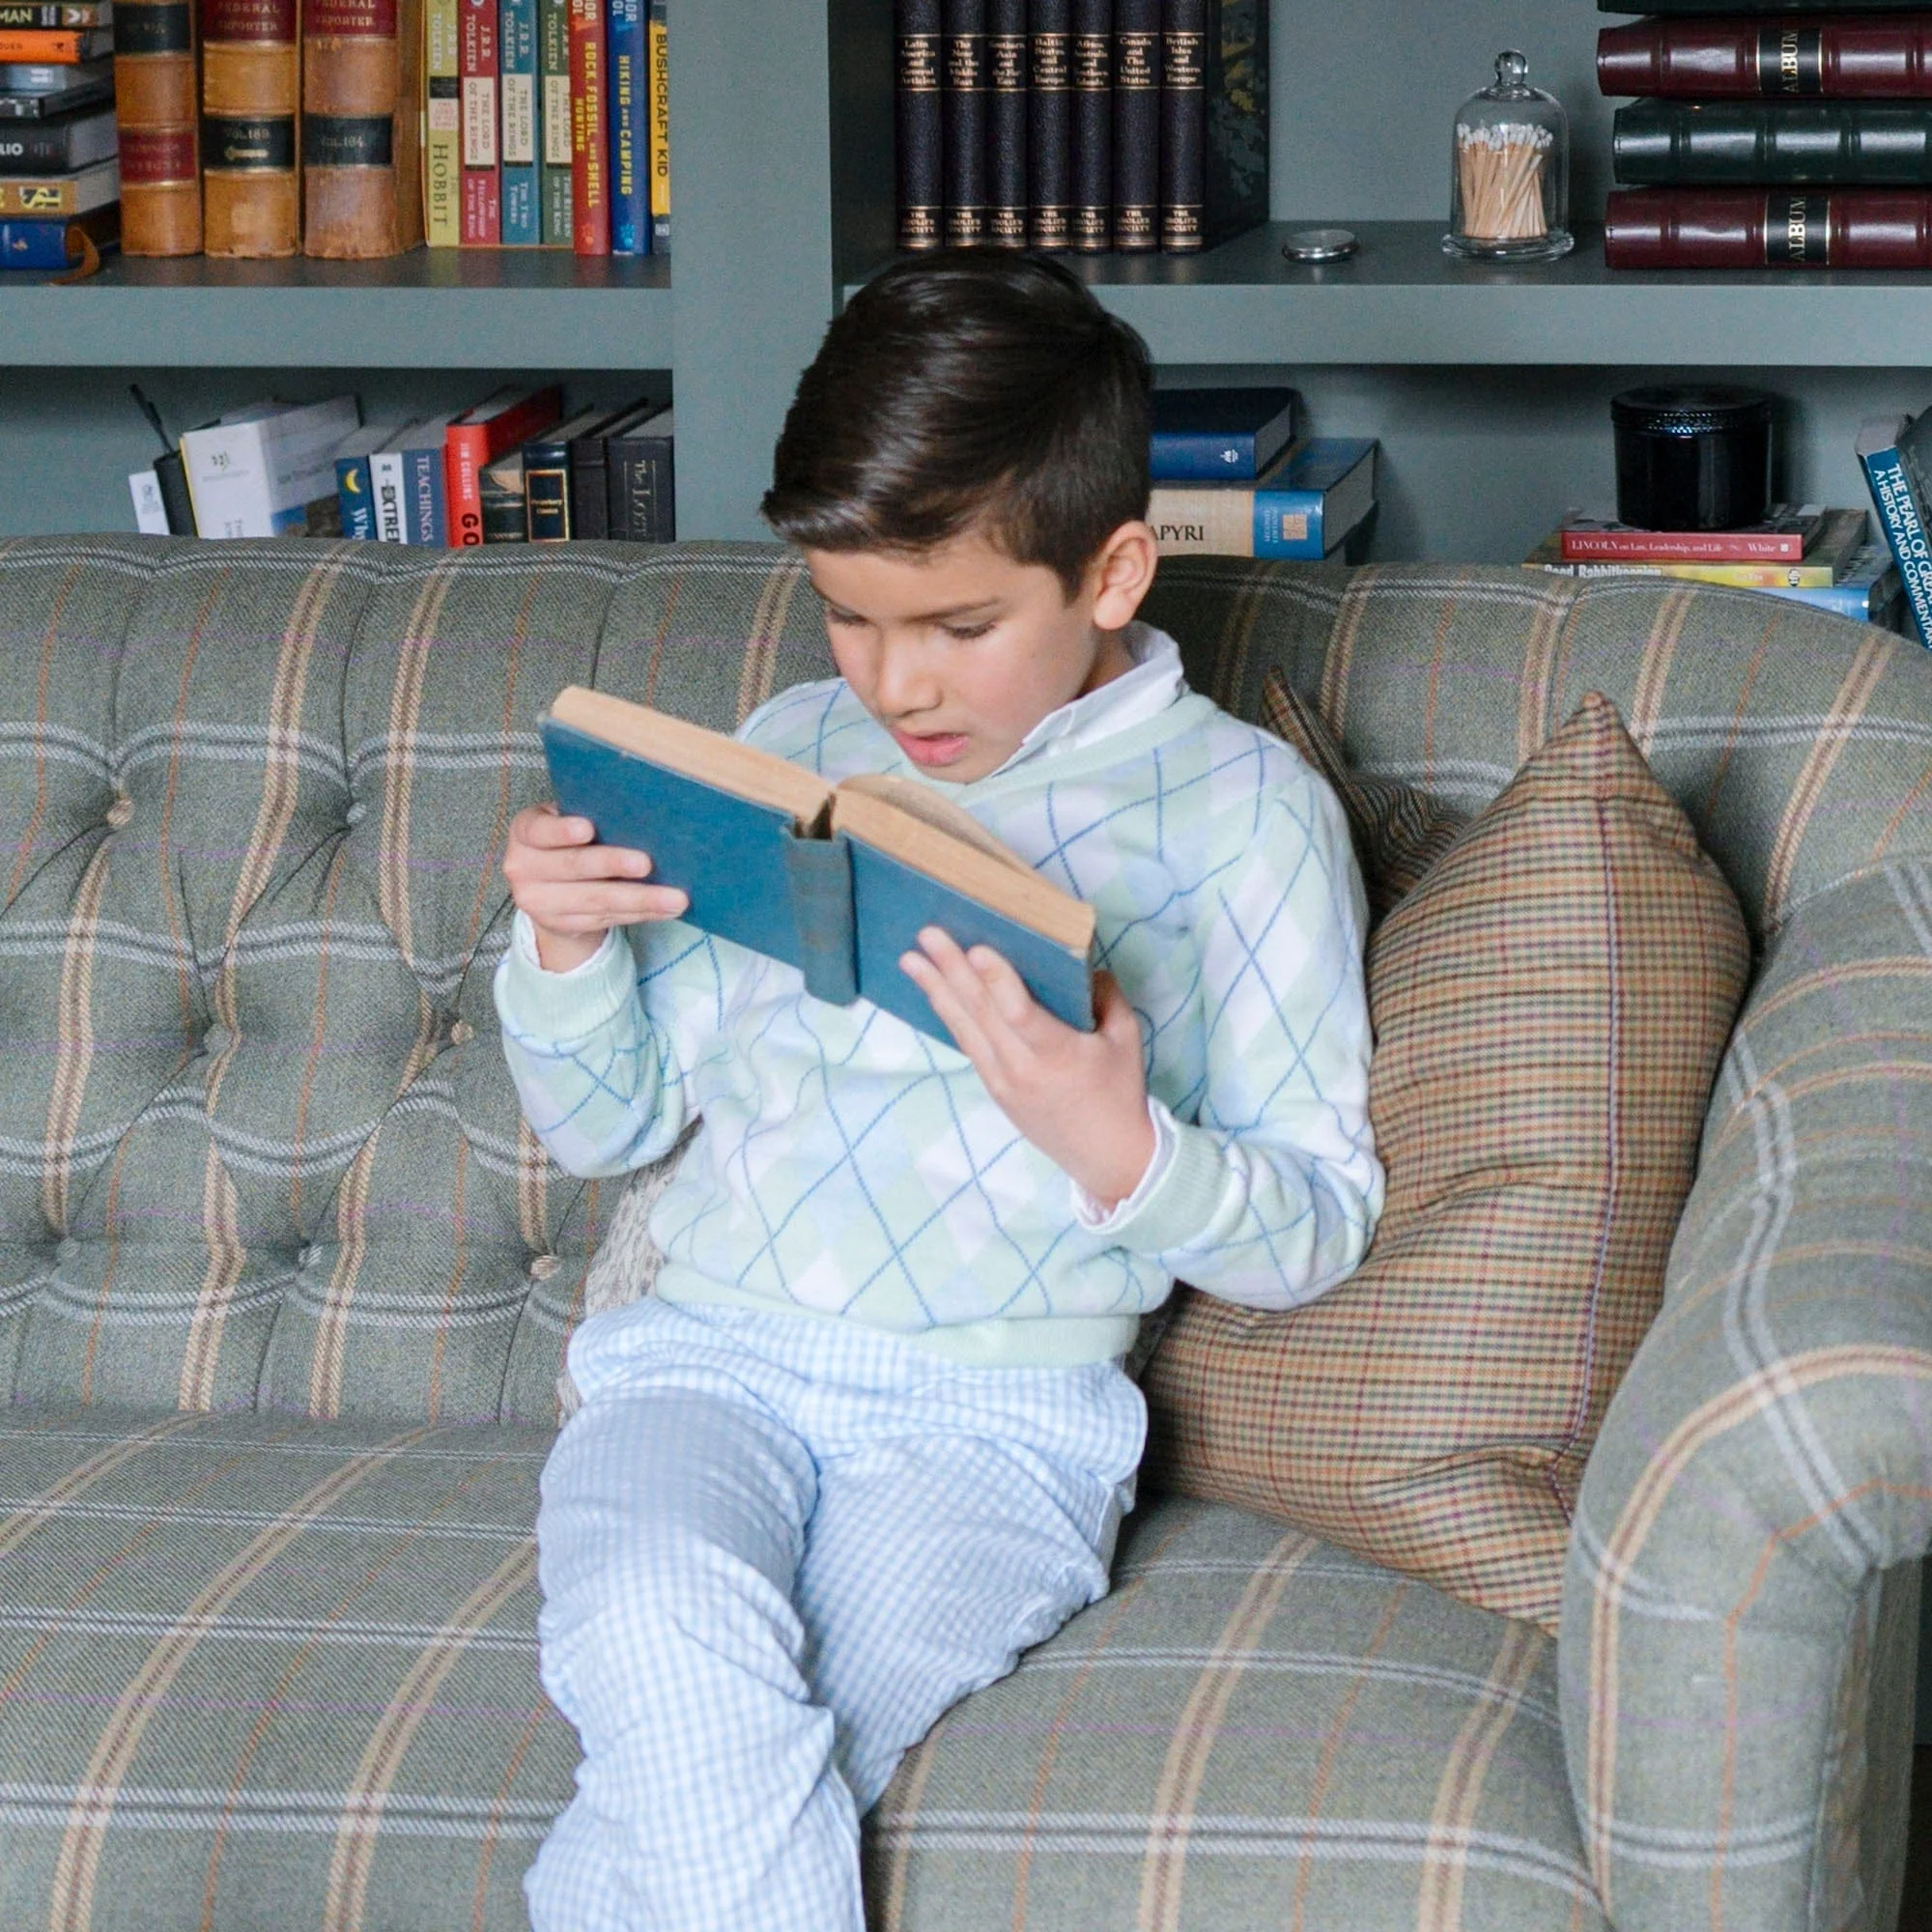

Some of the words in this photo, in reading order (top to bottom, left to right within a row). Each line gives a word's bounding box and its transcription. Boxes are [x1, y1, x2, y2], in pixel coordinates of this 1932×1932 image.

[466, 14, 477, 72] TOLKIEN
[505, 11, 515, 70] TOLKIEN
[548, 13, 558, 71] TOLKIEN
[1121, 37, 1152, 46] Canada
[1126, 46, 1144, 55] and
[1166, 38, 1199, 46] British
[1121, 66, 1151, 74] United
[1124, 56, 1145, 65] The
[1165, 64, 1201, 72] Western
[1174, 55, 1189, 64] and
[1781, 30, 1799, 94] ALBUM
[469, 81, 477, 96] OF
[508, 78, 516, 93] OF
[551, 80, 558, 94] OF
[619, 55, 631, 105] HIKING
[656, 34, 668, 143] BUSHCRAFT
[469, 99, 478, 122] THE
[508, 123, 517, 156] RINGS
[520, 116, 528, 147] LORD
[552, 124, 560, 158] RINGS
[620, 129, 633, 196] CAMPING
[657, 149, 668, 177] KID
[433, 144, 448, 226] HOBBIT
[587, 162, 600, 209] SHELL
[1788, 195, 1805, 262] ALBUM
[1874, 469, 1886, 481] A
[1887, 463, 1908, 497] THE
[381, 486, 401, 542] EXTRE
[417, 456, 433, 541] TEACHINGS
[1878, 480, 1904, 530] HISTORY
[1897, 494, 1921, 541] PEARL
[1571, 540, 1618, 551] LINCOLN
[1893, 530, 1912, 560] AND
[1911, 539, 1928, 560] OF
